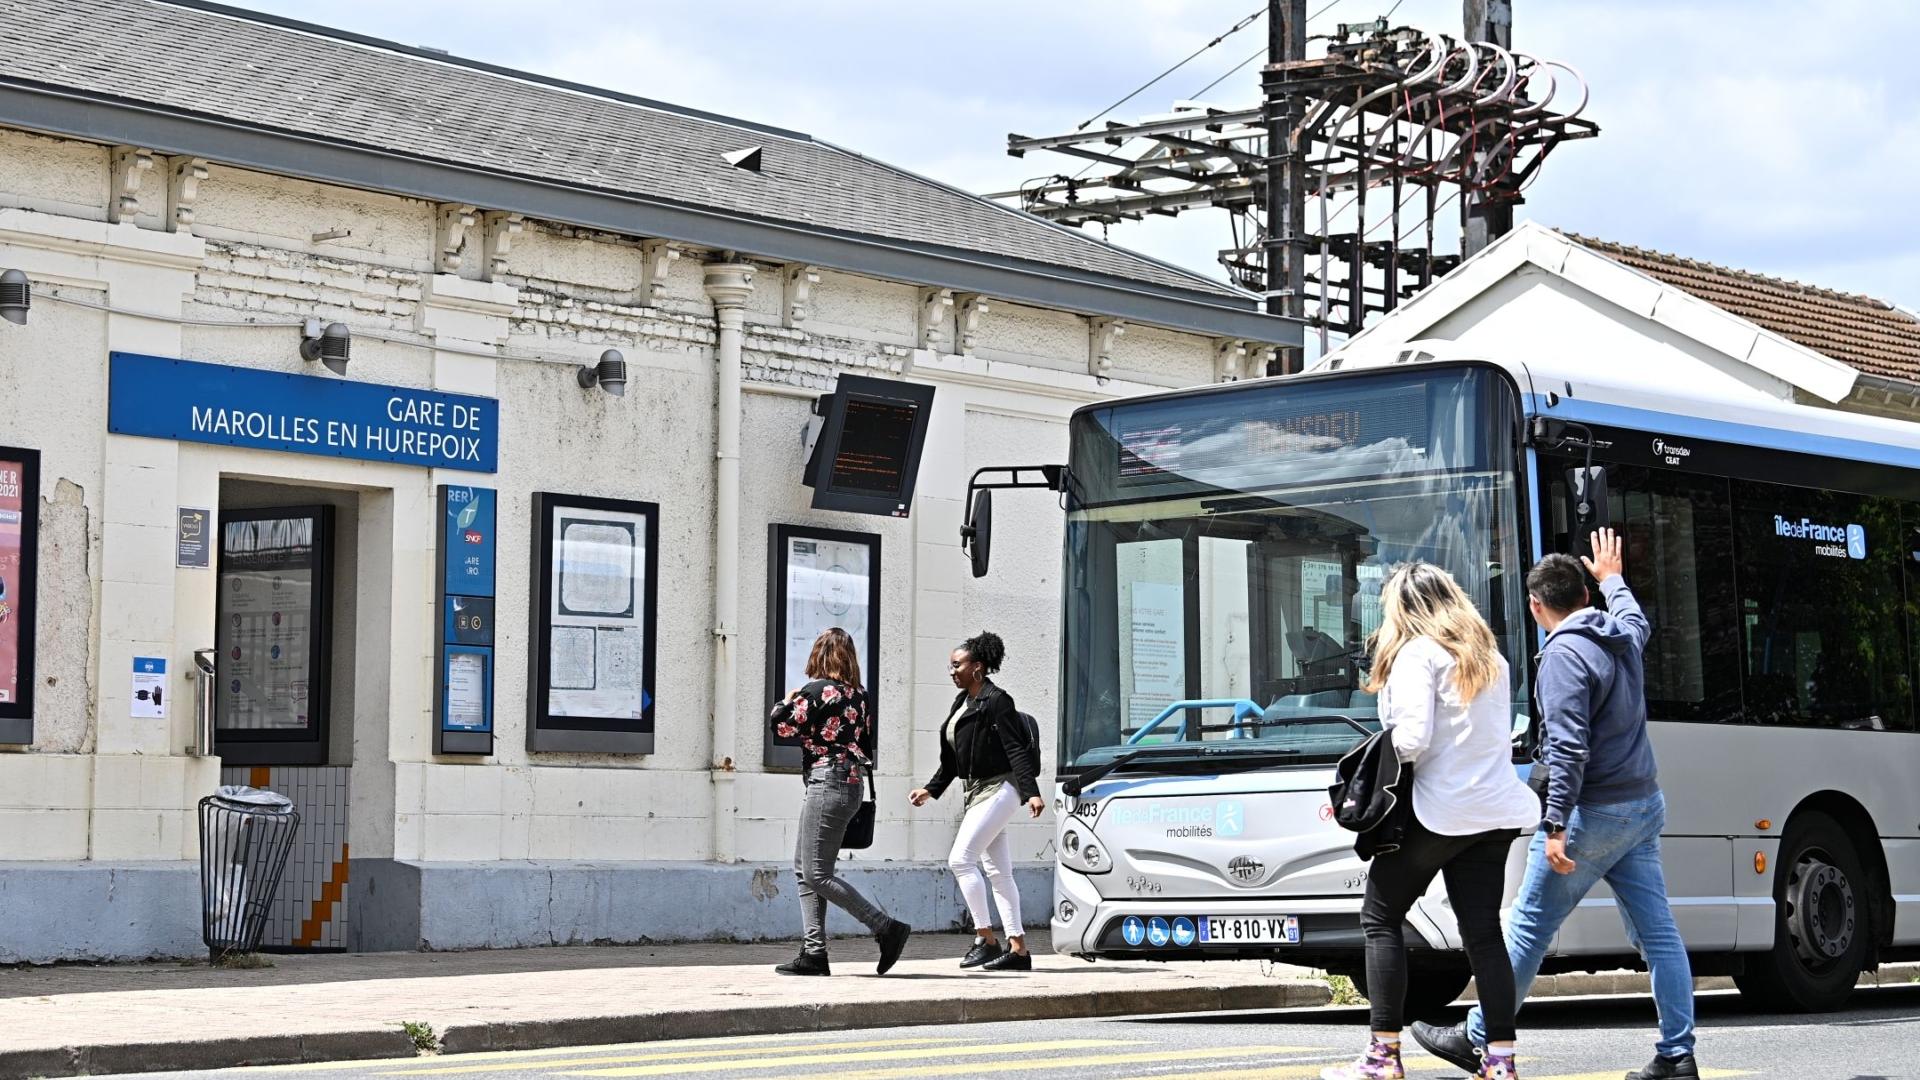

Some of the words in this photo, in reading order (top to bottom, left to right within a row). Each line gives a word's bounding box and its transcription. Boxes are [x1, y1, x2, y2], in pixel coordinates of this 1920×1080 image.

[387, 396, 446, 427] GARE
[452, 404, 481, 431] DE
[192, 405, 319, 444] MAROLLES
[327, 421, 358, 449] EN
[366, 424, 481, 462] HUREPOIX
[1664, 443, 1691, 457] transdev
[1665, 456, 1681, 466] CEAT
[447, 489, 469, 503] RER
[464, 534, 482, 543] SNCF
[1815, 544, 1848, 559] mobilités
[1077, 802, 1098, 817] 403
[1166, 825, 1213, 838] mobilités
[1289, 929, 1298, 938] 91
